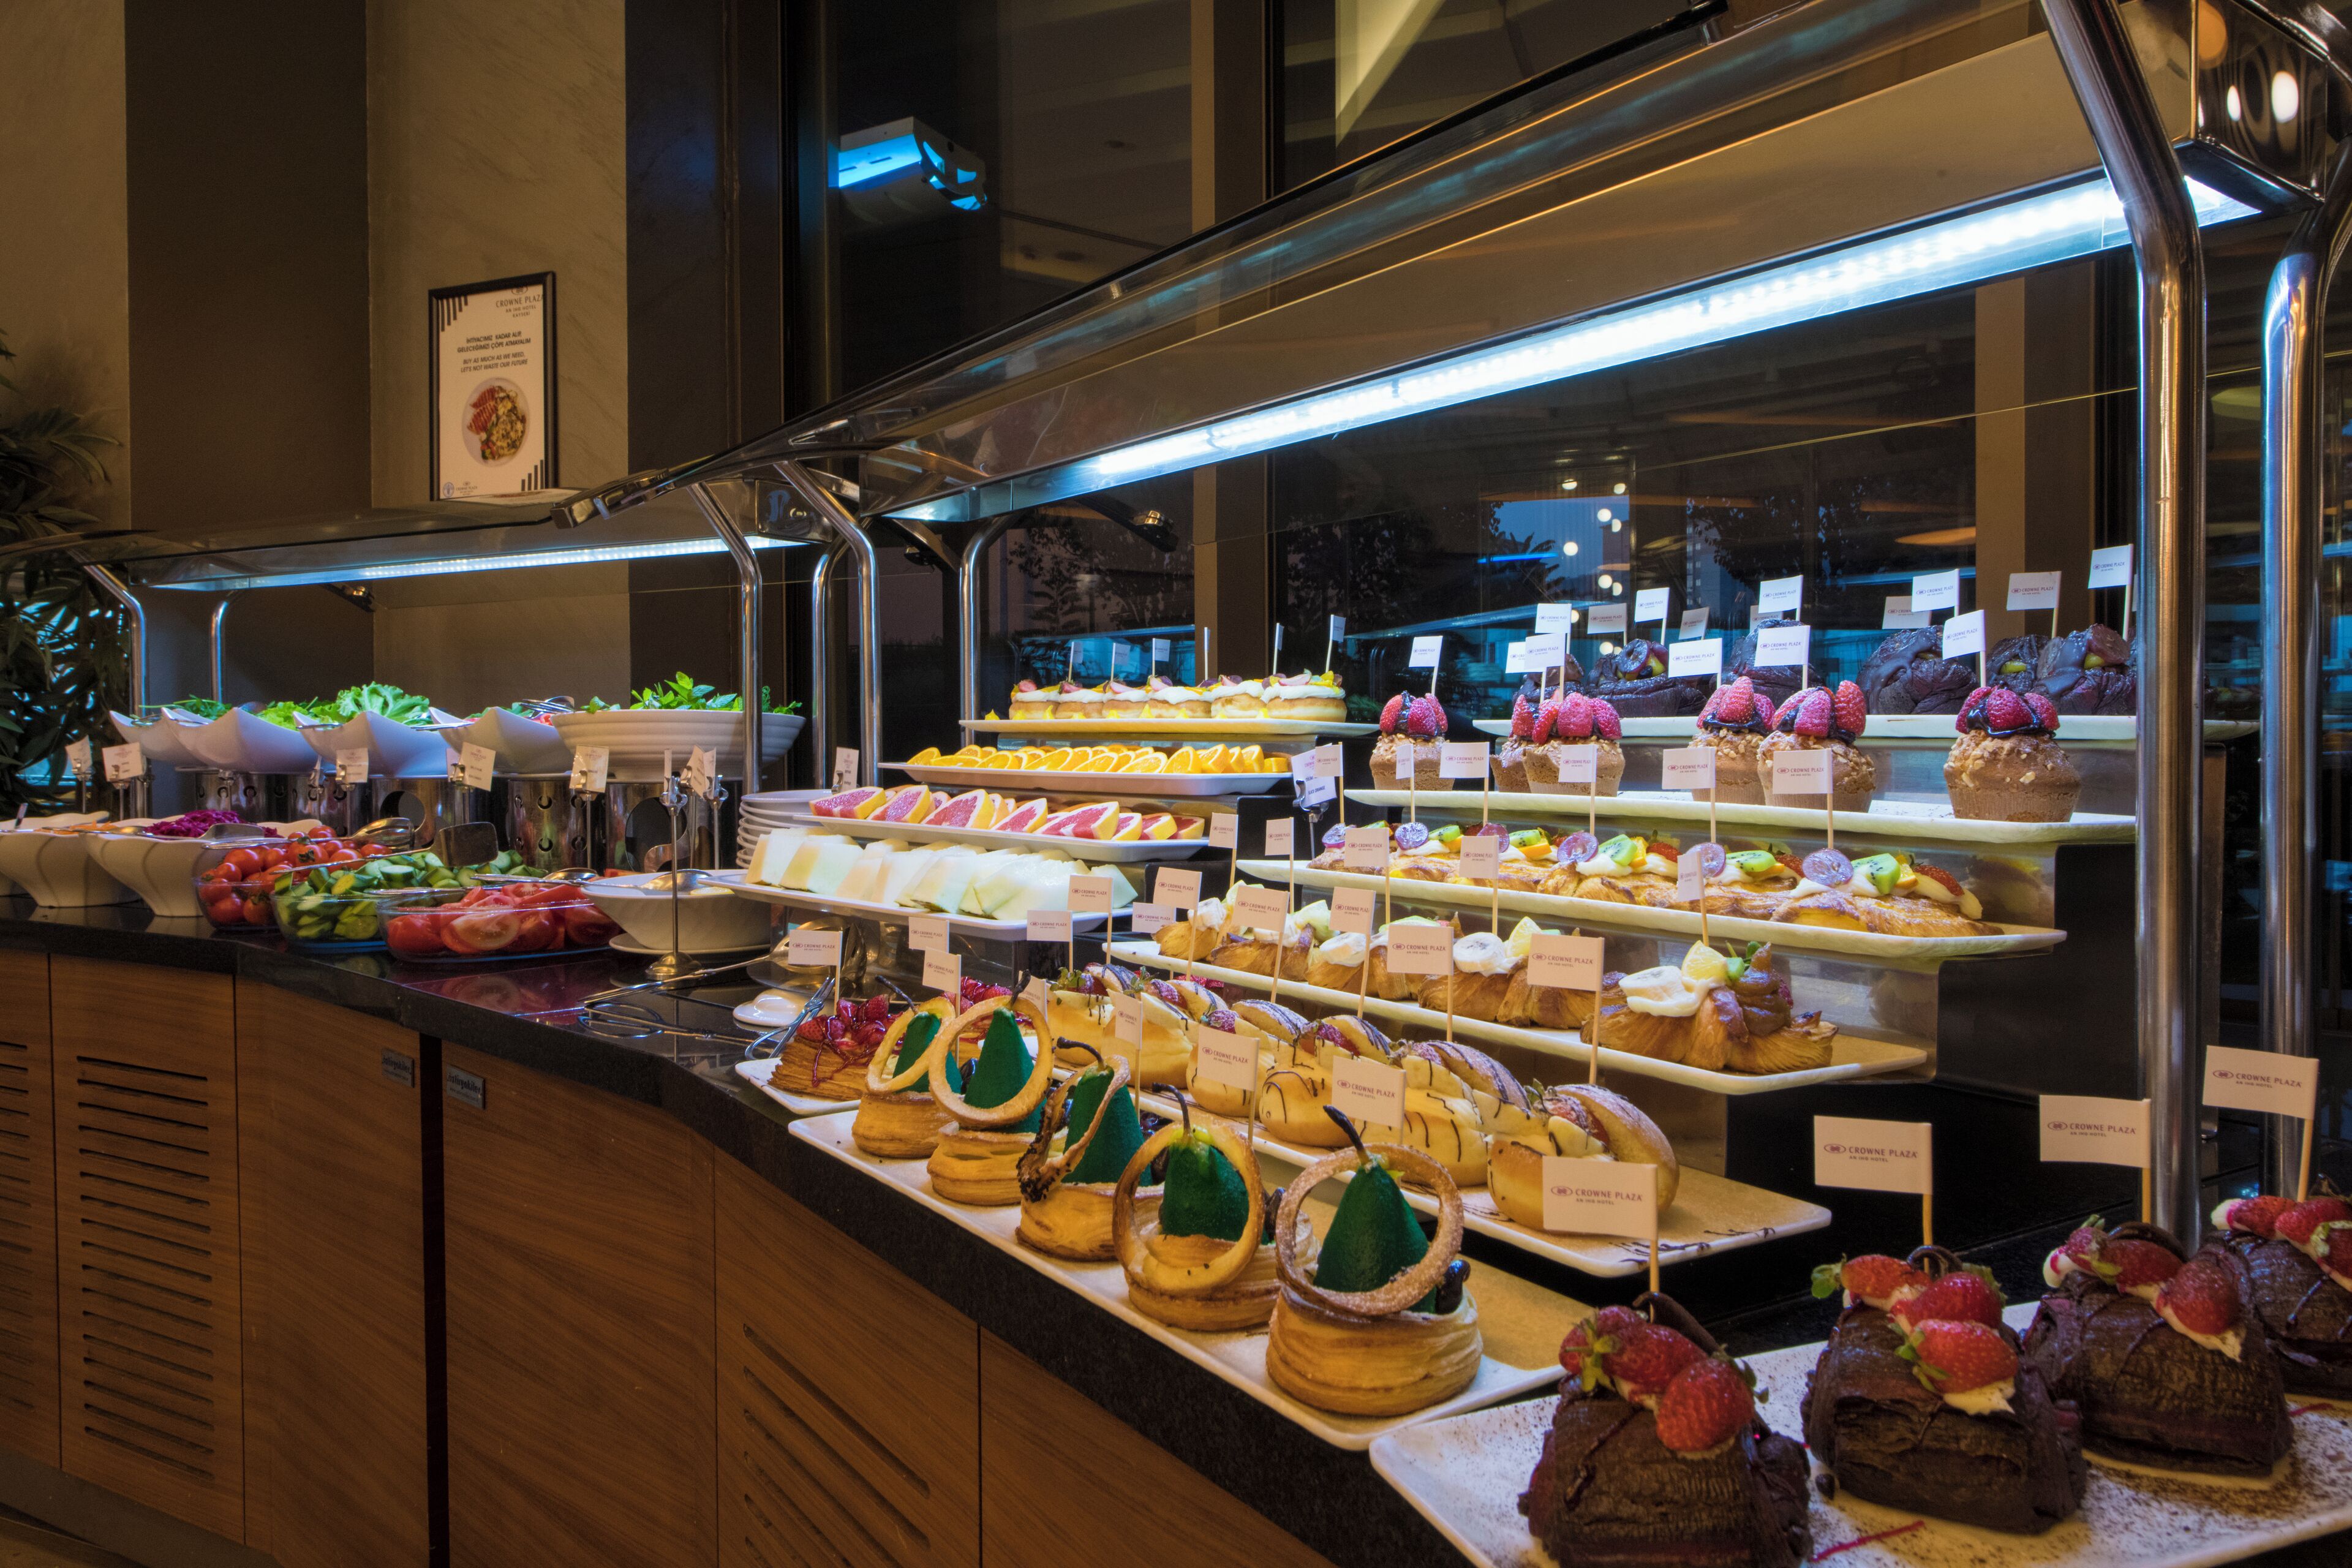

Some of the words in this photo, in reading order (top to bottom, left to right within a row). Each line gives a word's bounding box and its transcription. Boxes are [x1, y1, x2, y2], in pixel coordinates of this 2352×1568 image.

[496, 297, 522, 308] CROWNE
[491, 341, 504, 350] ÇÖPE
[505, 337, 531, 347] ATMAYALIM
[1213, 1050, 1231, 1060] CROWNE
[1232, 1055, 1248, 1064] PLAZA
[2236, 1073, 2271, 1083] CROWNE
[2274, 1077, 2302, 1088] PLAZA
[1352, 1084, 1374, 1095] CROWNE
[1376, 1088, 1395, 1098] PLAZA
[2070, 1123, 2104, 1131] CROWNE
[2108, 1125, 2136, 1135] PLAZA
[1849, 1146, 1886, 1156] CROWNE
[1889, 1149, 1918, 1159] PLAZA
[1575, 1188, 1611, 1199] CROWNE
[1615, 1191, 1643, 1202] PLAZA
